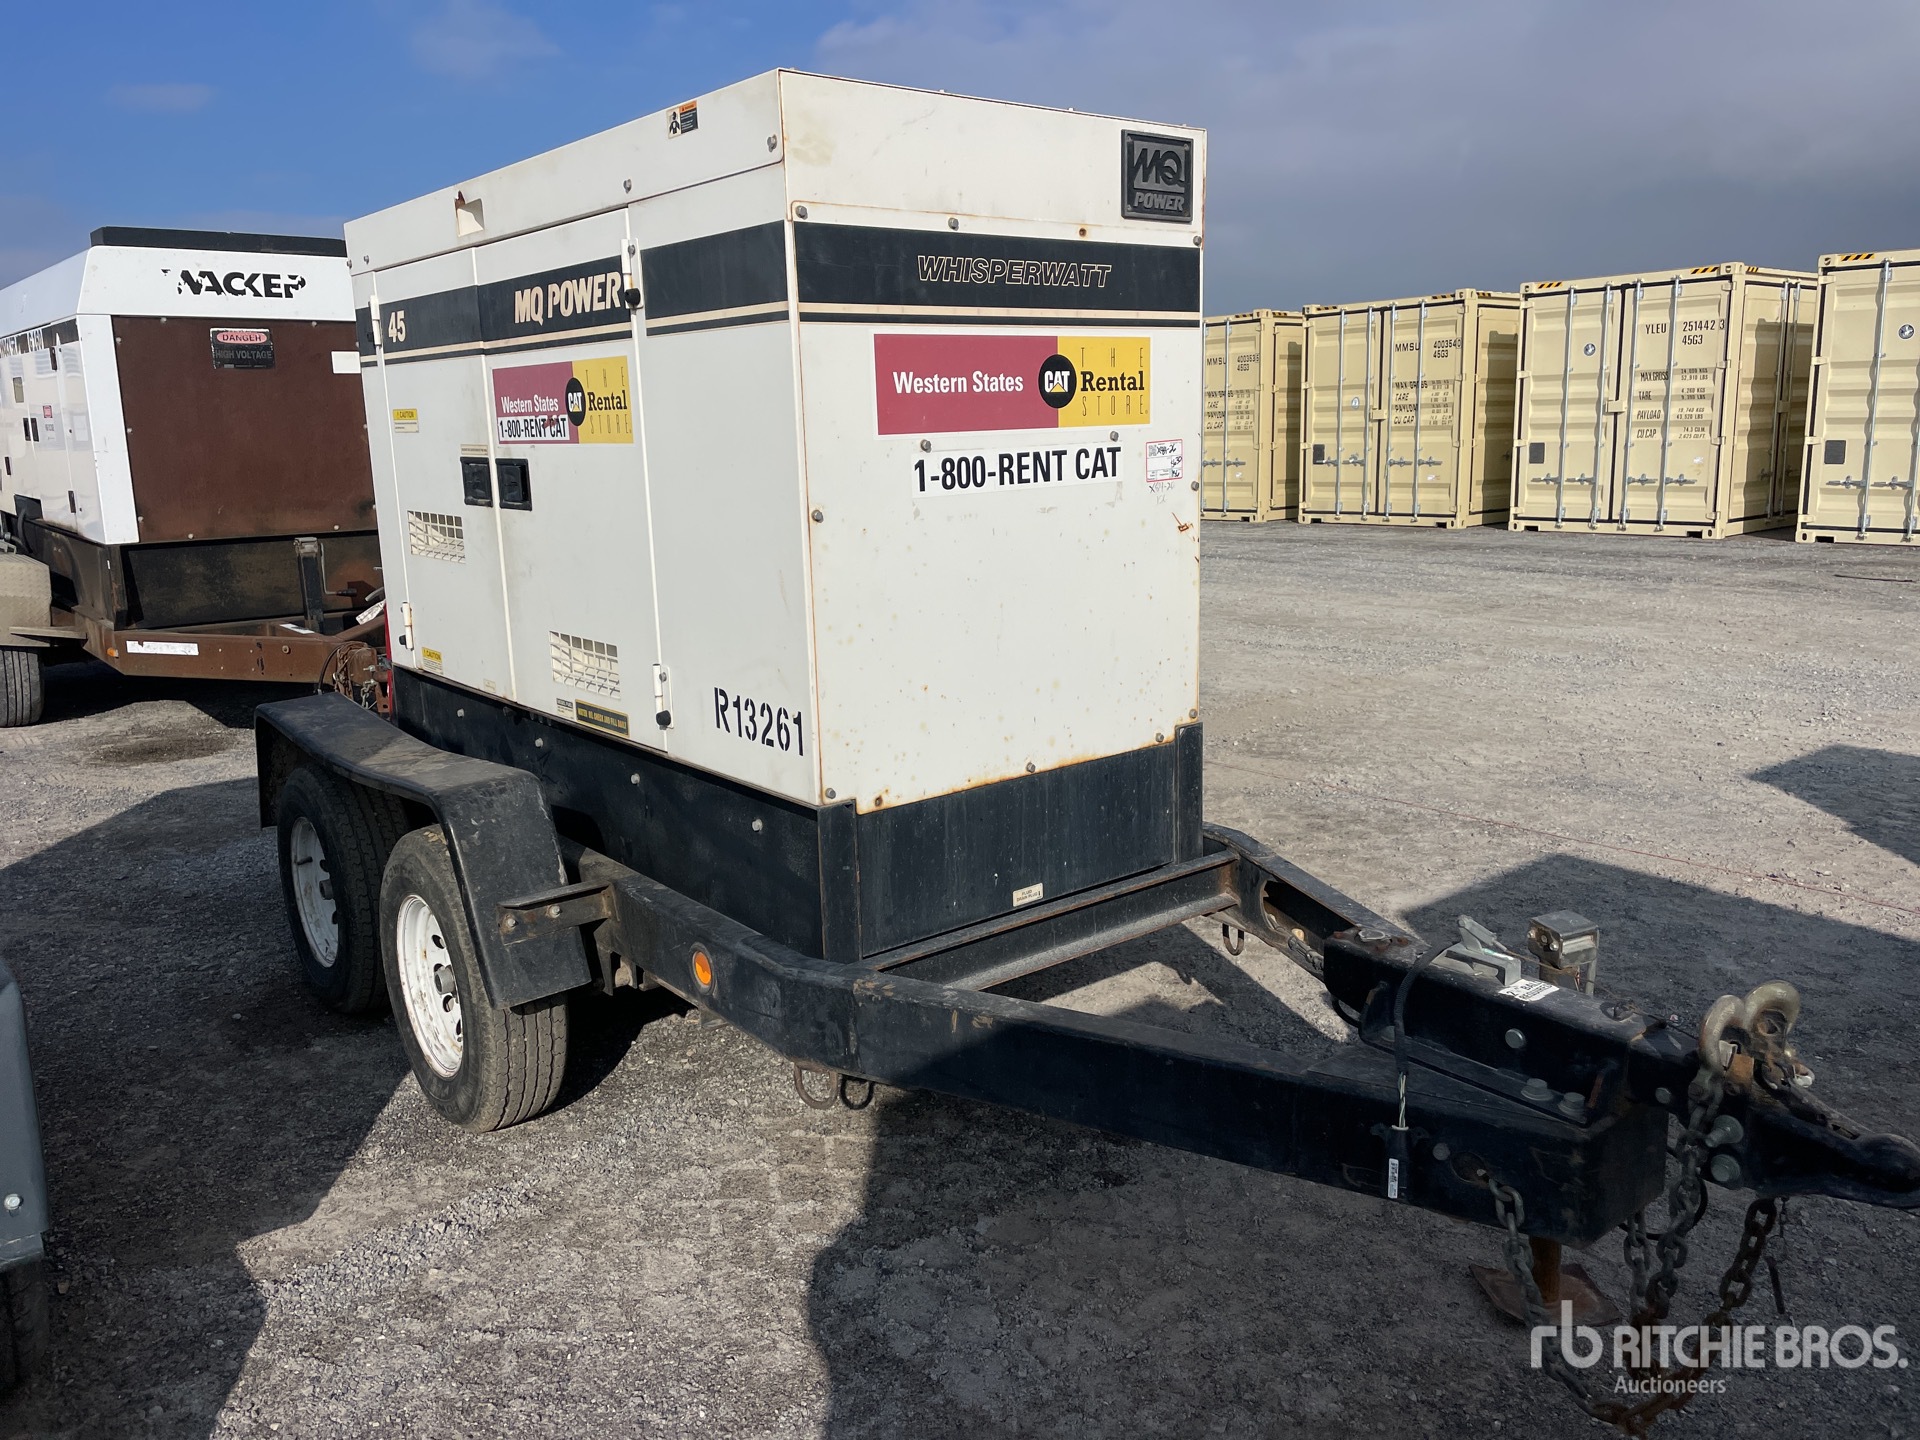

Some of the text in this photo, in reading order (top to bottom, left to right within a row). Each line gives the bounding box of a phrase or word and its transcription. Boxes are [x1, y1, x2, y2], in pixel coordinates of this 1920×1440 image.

[1128, 147, 1185, 188] MQ
[1133, 192, 1185, 212] POWER
[917, 255, 1112, 288] WHISPERWATT
[514, 271, 622, 327] MQ POWER
[388, 310, 406, 343] 45
[1645, 323, 1667, 334] YLEU
[1683, 319, 1716, 332] 251442
[222, 333, 262, 342] DANGER
[1395, 342, 1420, 352] MMSU
[1682, 334, 1703, 345] 45G3
[215, 349, 273, 360] HIGH VOLTAGE
[1081, 347, 1144, 368] THE
[1433, 349, 1448, 358] 45G3
[892, 370, 1145, 394] Western States CAT Rental
[1395, 381, 1408, 389] MAX
[1409, 380, 1428, 389] GRSS
[501, 390, 628, 414] Western States CAT Rental
[1395, 393, 1409, 401] TARE
[1638, 390, 1652, 400] TARE
[1636, 409, 1662, 420] PAYLOAD
[499, 418, 567, 438] 1-800-RENT CAT
[914, 446, 1122, 492] 1-800-RENT CAT
[713, 686, 804, 757] R13261
